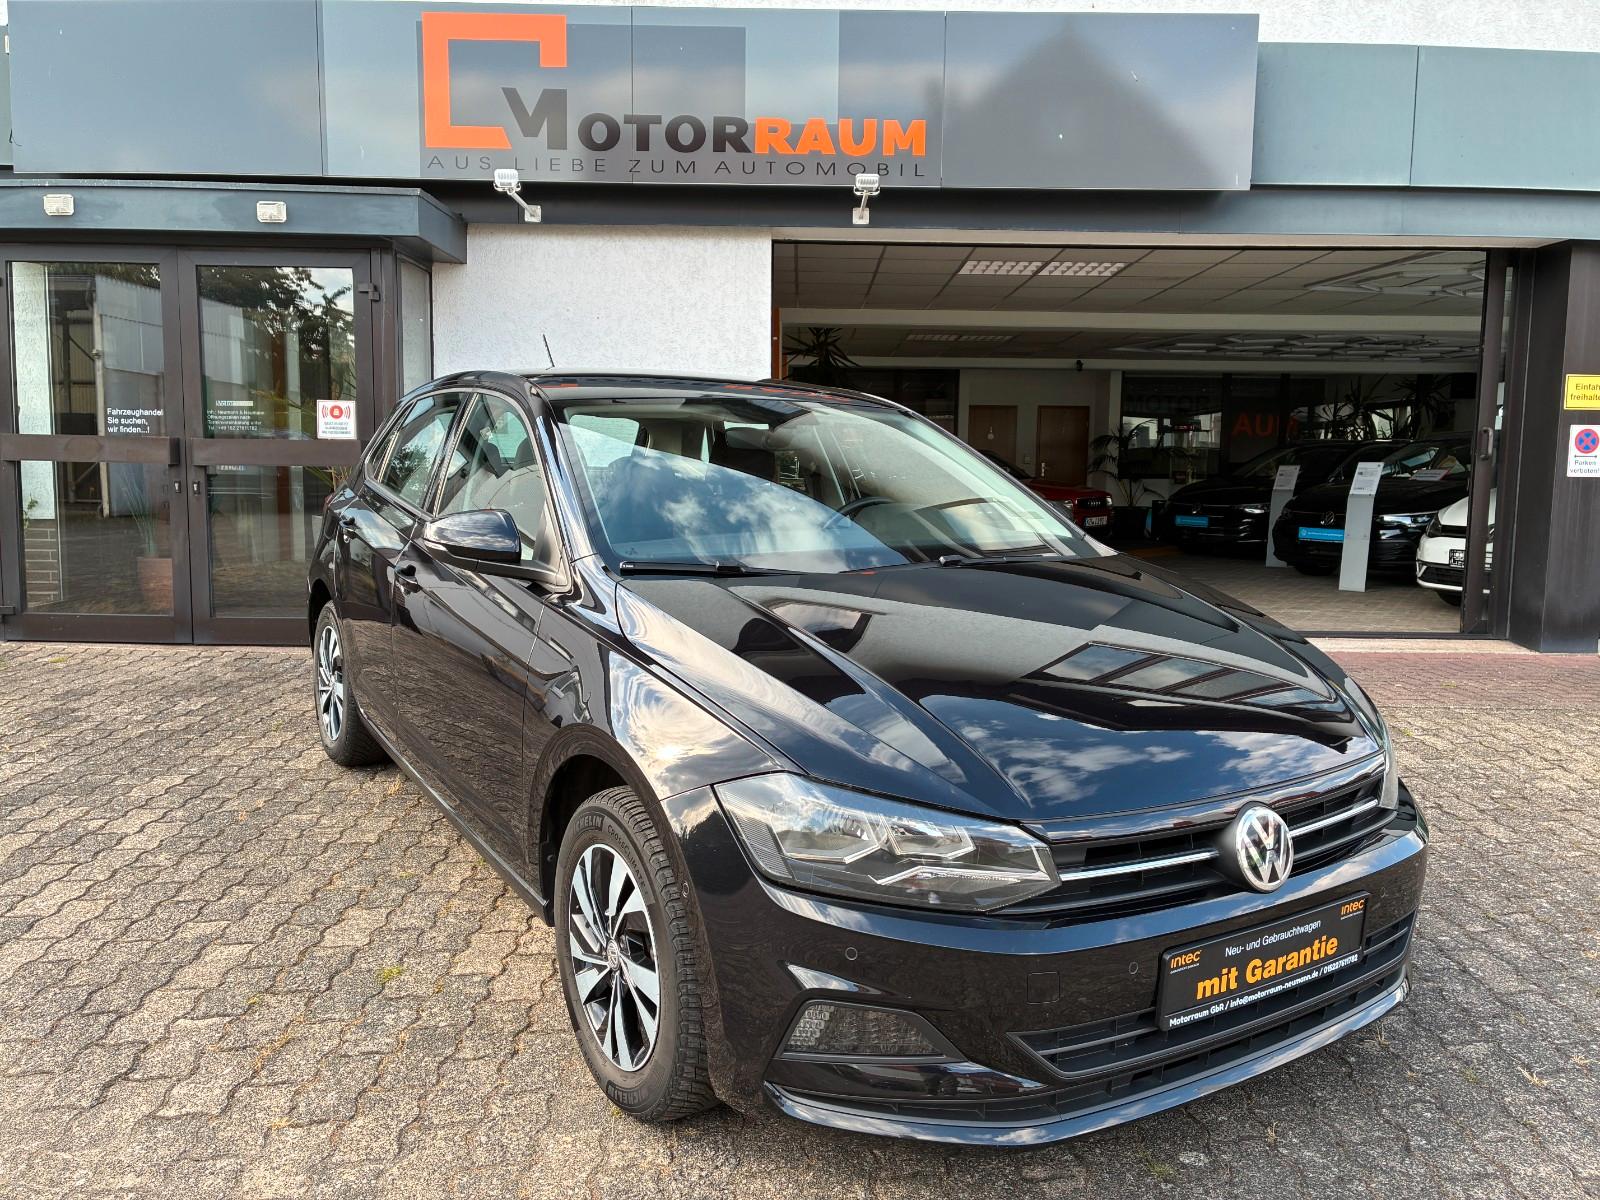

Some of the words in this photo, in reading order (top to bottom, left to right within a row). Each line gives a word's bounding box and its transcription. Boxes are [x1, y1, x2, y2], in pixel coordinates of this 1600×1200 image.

[427, 155, 492, 170] AUS
[514, 157, 606, 172] LIEBE
[628, 159, 696, 174] ZUM
[714, 160, 925, 177] AUTOMOBIL
[107, 408, 164, 417] Fahrzeughandel
[120, 417, 148, 425] suchen,
[1225, 946, 1245, 957] Neu-
[1246, 938, 1260, 951] und
[1262, 920, 1321, 946] Gebrauchtwagen
[1196, 967, 1239, 1000] mit
[1246, 935, 1338, 983] Garantie
[1169, 1009, 1209, 1027] Motorraum
[1210, 1003, 1225, 1014] GbR
[1229, 970, 1319, 1008] info@motorraum-neumann.de
